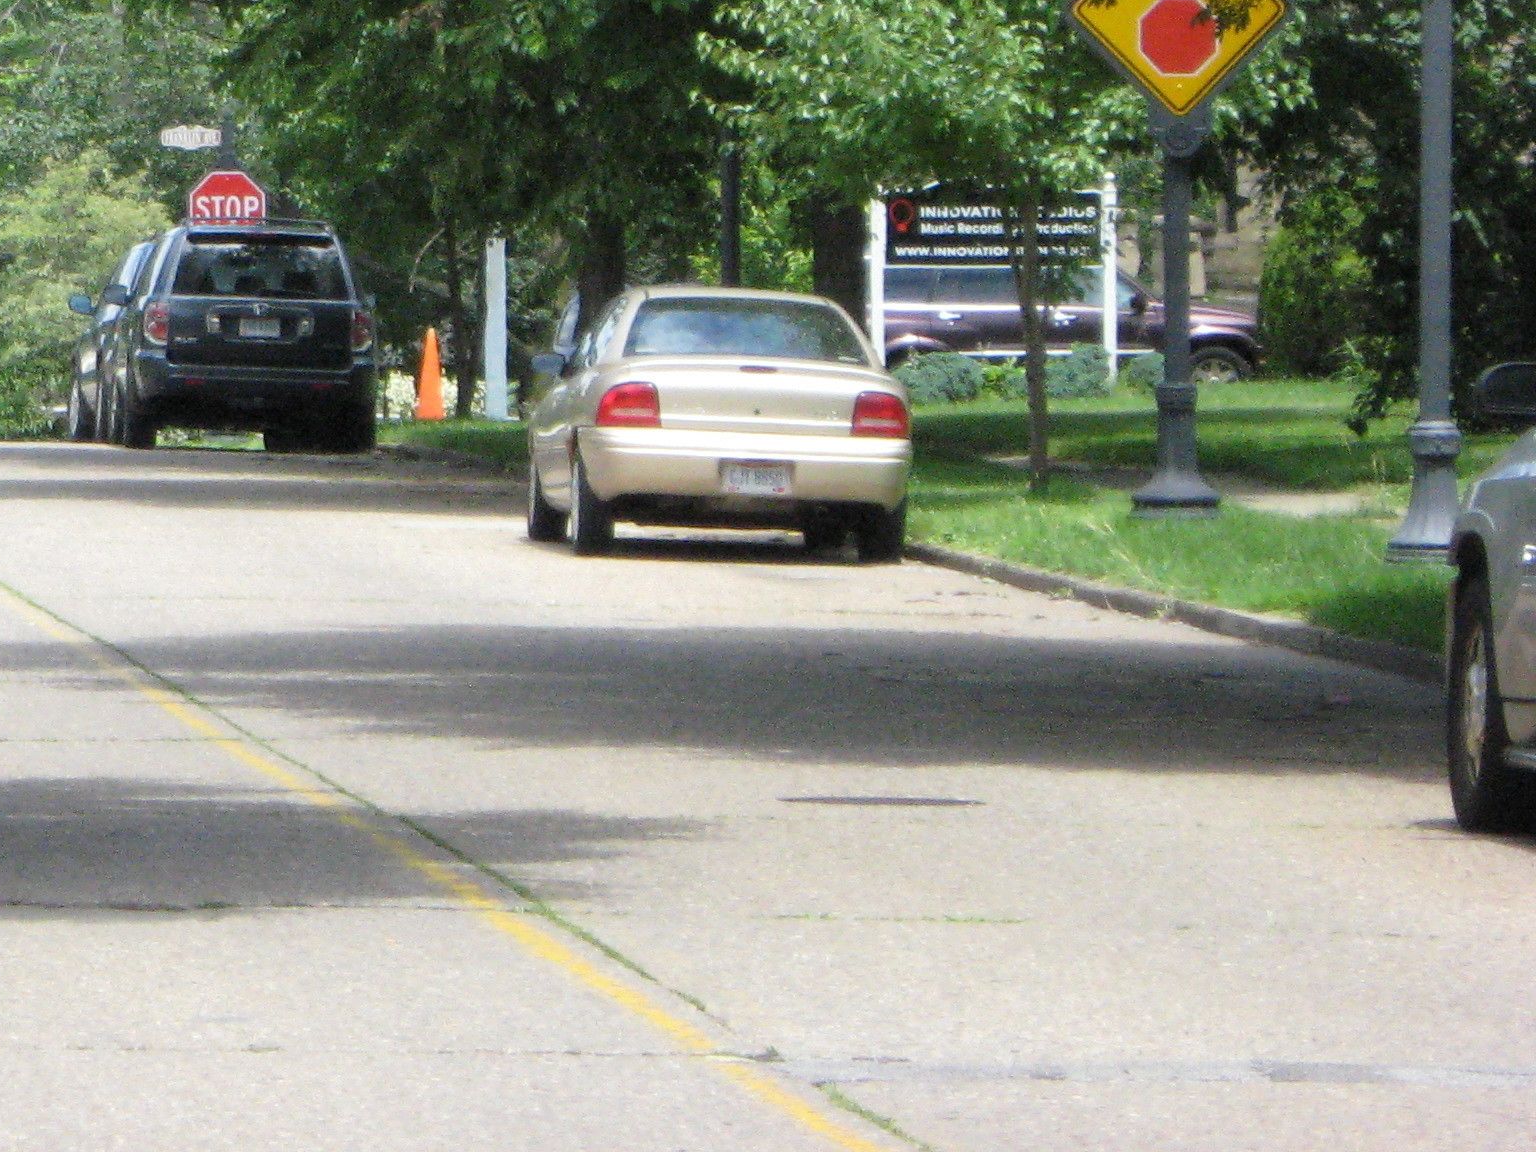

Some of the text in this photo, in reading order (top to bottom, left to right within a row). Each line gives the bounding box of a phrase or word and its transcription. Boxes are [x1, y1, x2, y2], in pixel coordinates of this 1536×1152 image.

[196, 195, 260, 224] STOP
[920, 223, 956, 235] Music
[1035, 223, 1096, 235] roduction
